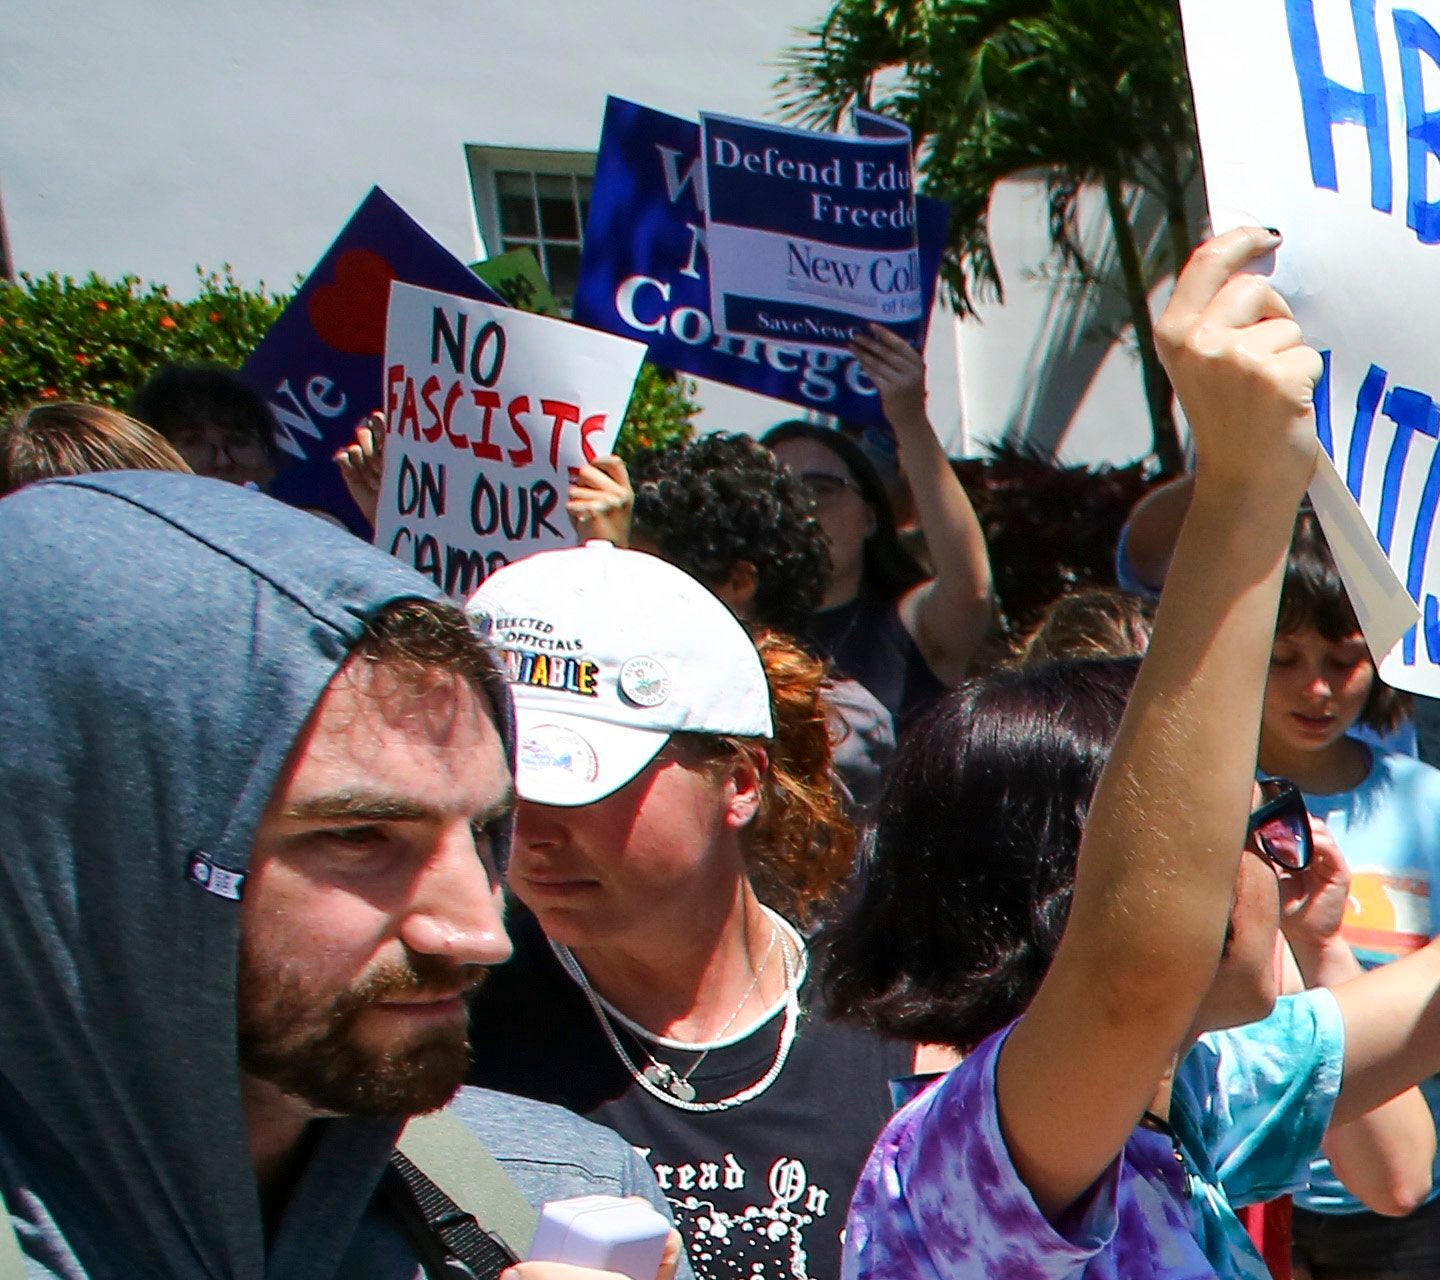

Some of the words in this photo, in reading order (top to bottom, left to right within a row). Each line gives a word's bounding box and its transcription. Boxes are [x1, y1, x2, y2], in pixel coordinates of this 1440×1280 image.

[711, 137, 842, 187] Defend
[787, 241, 861, 289] New
[431, 305, 507, 388] NO
[266, 376, 347, 460] We
[386, 364, 608, 474] FASCISTS
[397, 453, 447, 519] ON
[470, 471, 566, 541] OUR
[496, 617, 554, 634] ELECTED
[505, 631, 584, 651] OFFICIALS
[768, 1156, 830, 1217] On
